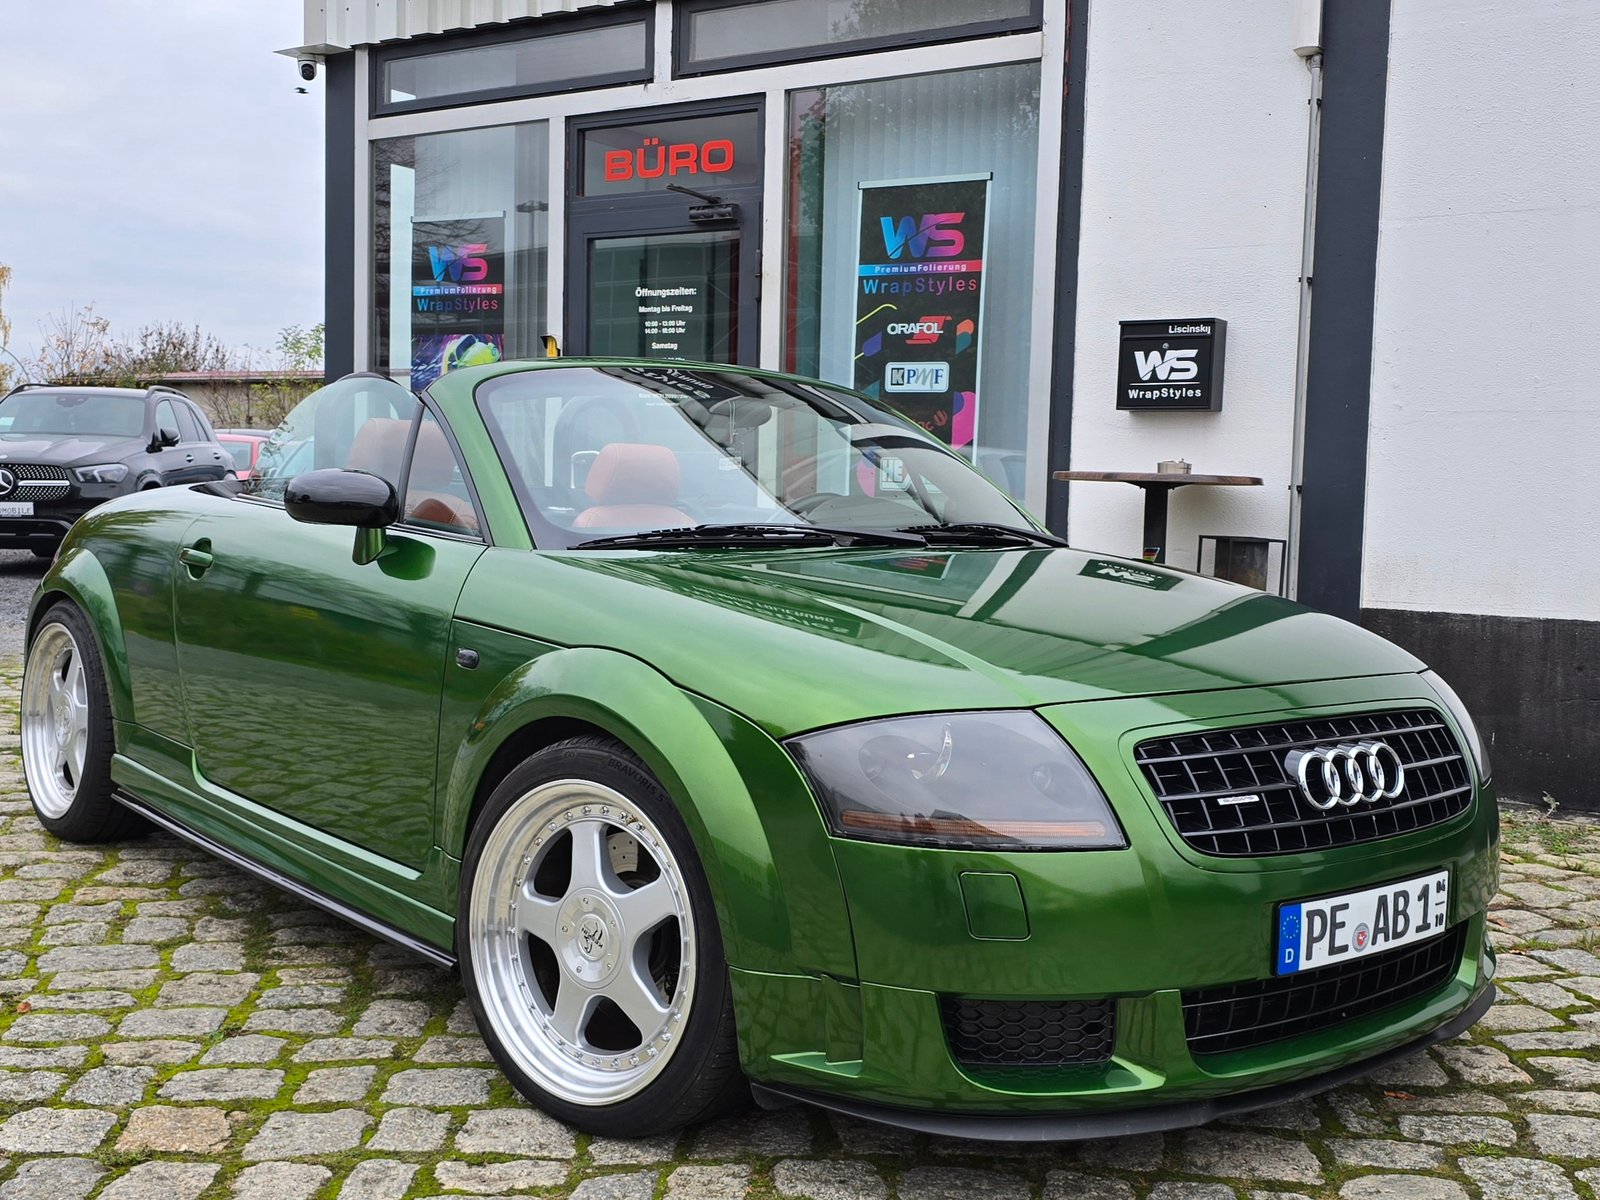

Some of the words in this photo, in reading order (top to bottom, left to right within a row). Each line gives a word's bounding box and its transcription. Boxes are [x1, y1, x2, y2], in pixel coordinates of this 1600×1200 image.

[604, 137, 735, 182] BÜRO
[880, 212, 965, 259] WS
[874, 263, 967, 274] PremiumFolierung
[635, 287, 697, 298] Öffnungszeiten:
[863, 276, 976, 296] WrapStyles
[417, 297, 498, 312] WrapStyles
[671, 305, 693, 313] Freitag
[887, 321, 944, 335] ORAFOL
[651, 342, 678, 350] Samstag
[1134, 349, 1199, 380] WS
[1128, 387, 1202, 400] WrapStyles
[1305, 902, 1350, 961] PE
[1371, 889, 1411, 945] AB
[1415, 883, 1431, 934] 1
[1284, 948, 1294, 963] D
